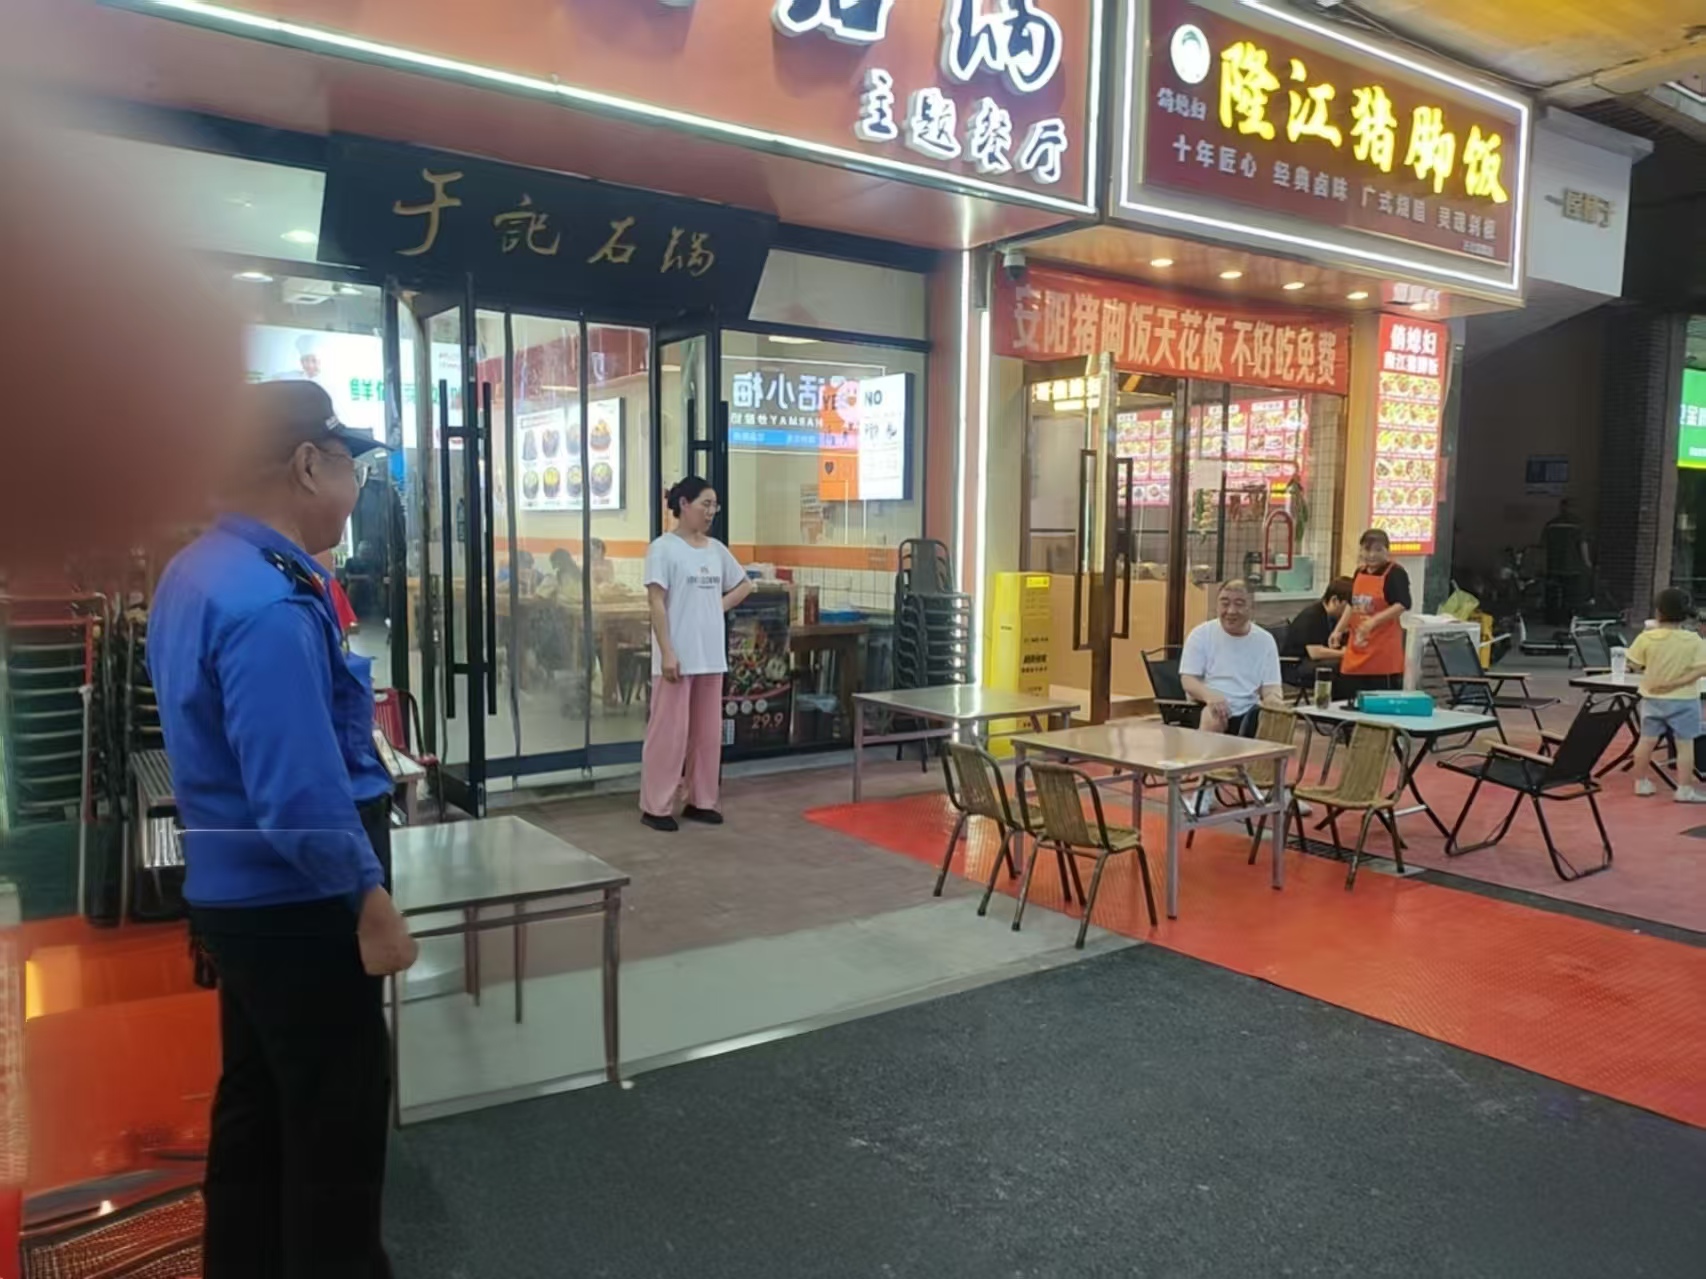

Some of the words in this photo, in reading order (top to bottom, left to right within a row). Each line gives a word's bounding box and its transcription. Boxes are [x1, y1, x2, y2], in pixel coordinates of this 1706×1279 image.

[855, 68, 1068, 183] 主题餐厅
[1172, 134, 1257, 178] 十年匠心
[1219, 41, 1508, 203] 隆江猪脚饭
[1013, 284, 1227, 372] 安阳猪脚饭天花板
[1230, 320, 1337, 386] 不好吃免费
[864, 390, 883, 407] NO
[752, 712, 784, 729] 29.9
